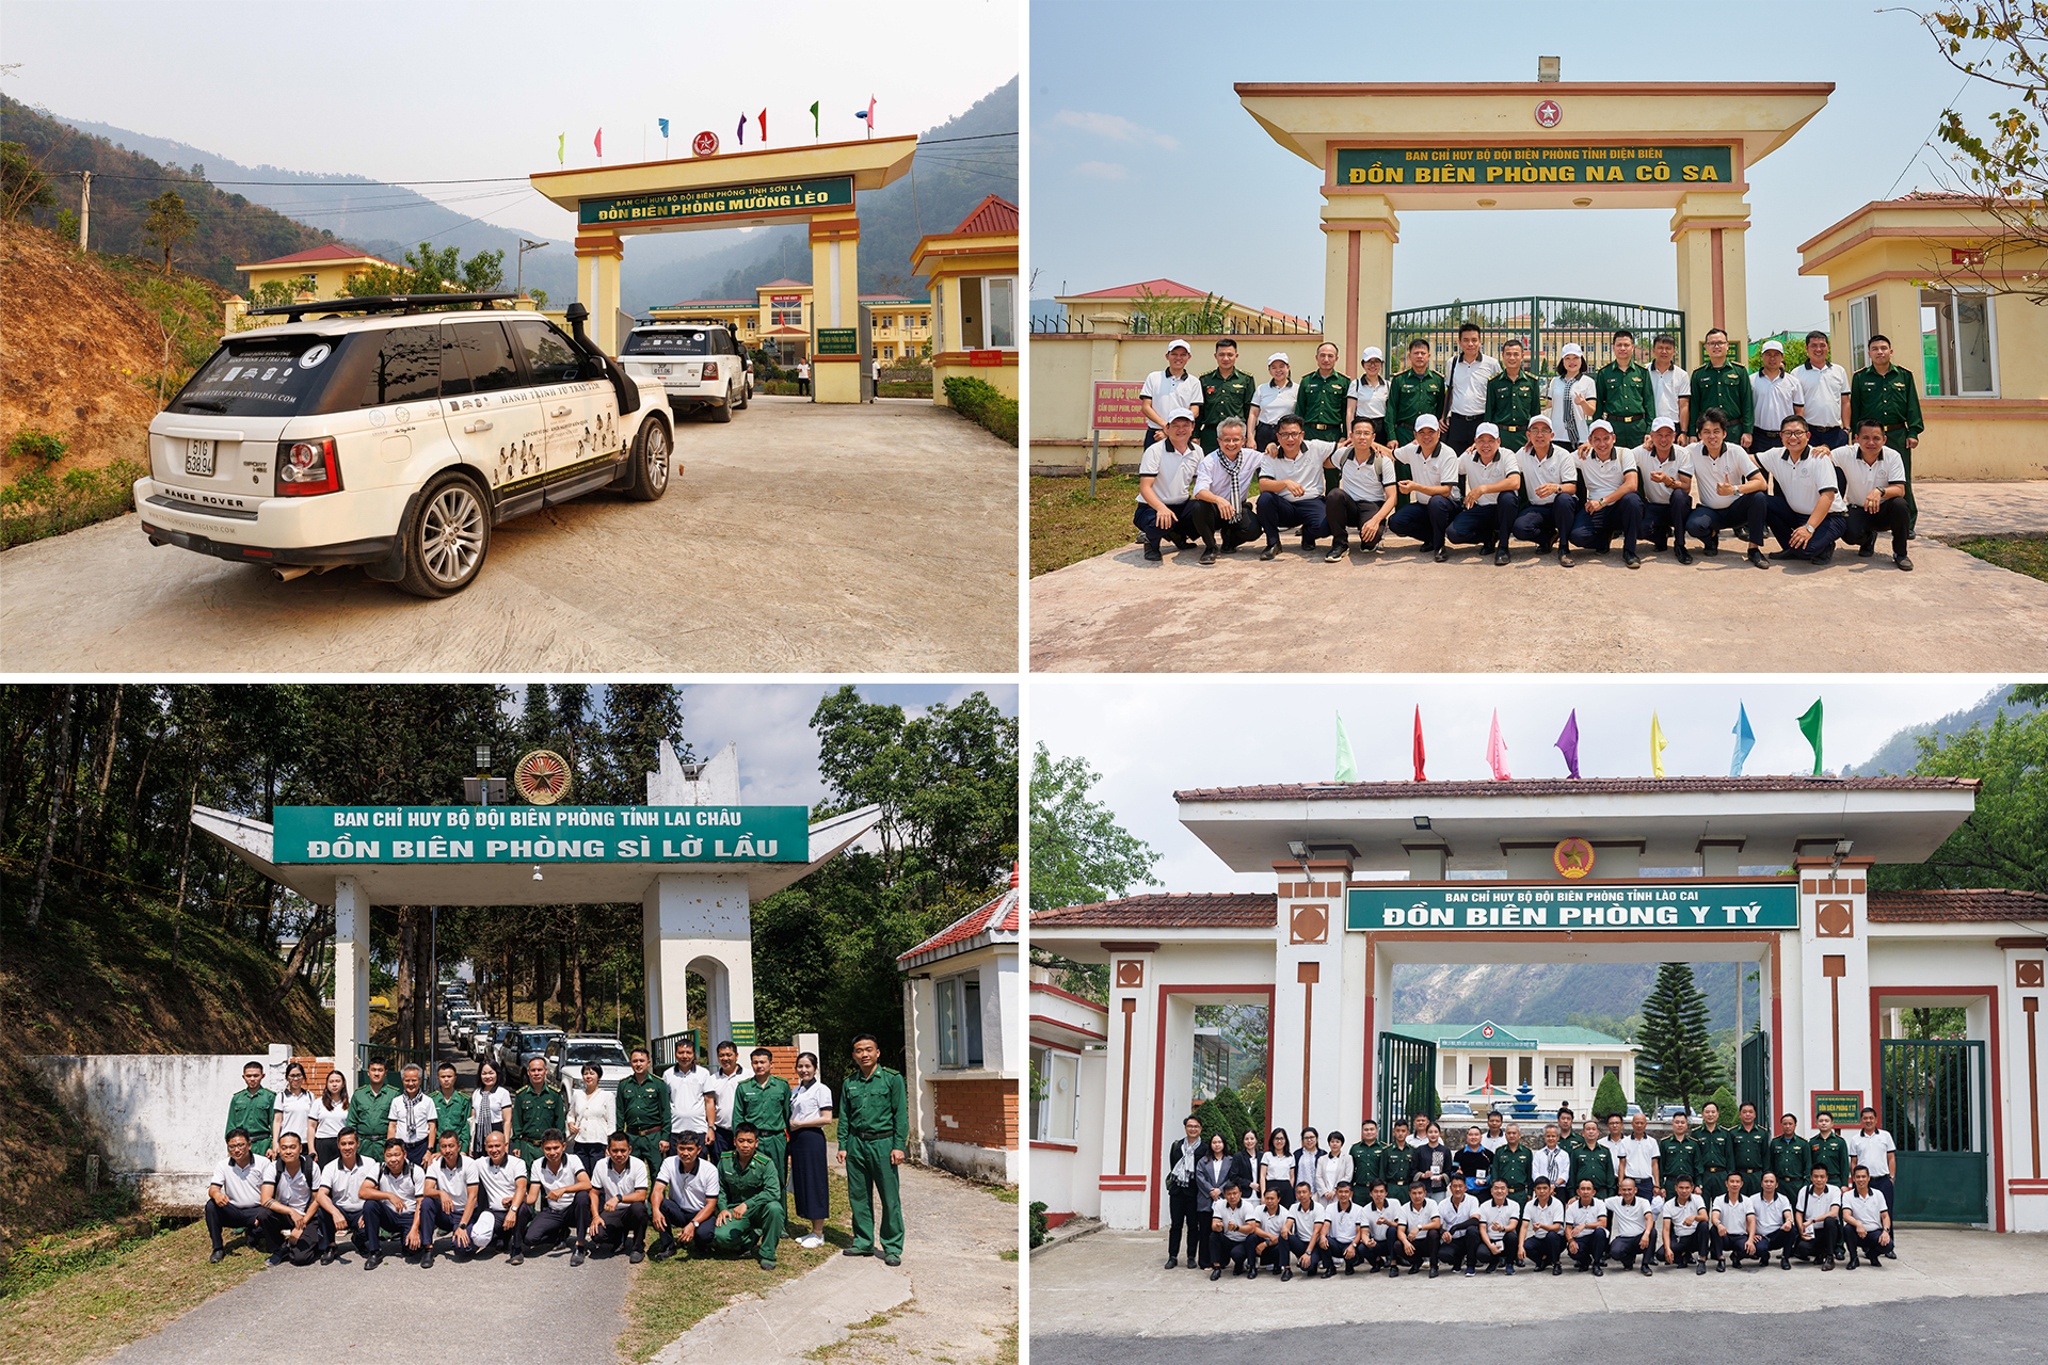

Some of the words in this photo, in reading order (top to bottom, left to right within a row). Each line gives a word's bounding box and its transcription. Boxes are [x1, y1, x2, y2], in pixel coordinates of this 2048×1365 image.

[1405, 151, 1429, 160] BAN
[1431, 149, 1450, 160] CHỈ
[1452, 151, 1474, 160] HUY
[1476, 149, 1491, 162] BỘ
[1493, 149, 1512, 162] ĐỘI
[1514, 148, 1539, 160] BIÊN
[1542, 148, 1580, 160] PHÒNG
[1581, 147, 1607, 160] TỈNH
[1609, 148, 1635, 160] ĐIỆN
[1637, 147, 1663, 159] BIÊN
[1349, 161, 1404, 183] ĐỒN
[1415, 164, 1475, 183] BIÊN
[1486, 161, 1576, 183] PHÒNG
[1586, 165, 1625, 182] NA
[1635, 161, 1671, 182] CÔ
[1682, 165, 1719, 182] SA
[634, 196, 648, 205] CHỈ
[649, 196, 666, 204] HUY
[667, 194, 678, 203] BỘ
[680, 192, 694, 202] ĐỘI
[696, 191, 714, 200] BIÊN
[716, 188, 746, 198] PHÒNG
[748, 186, 767, 195] TỈNH
[770, 184, 788, 193] SƠN
[598, 204, 629, 220] ĐỒN
[632, 204, 668, 218] BIÊN
[671, 200, 726, 215] PHÒNG
[728, 194, 792, 210] MƯỜNG
[794, 190, 829, 205] LÈO
[308, 348, 324, 364] 4
[1098, 388, 1111, 399] KHU
[1112, 387, 1124, 401] VỰC
[192, 440, 208, 456] 51G
[186, 456, 212, 473] 538.94
[165, 488, 196, 500] RANGE
[202, 496, 244, 508] ROVER
[334, 812, 369, 827] BAN
[372, 807, 402, 827] CHỈ
[408, 812, 442, 826] HUY
[446, 808, 470, 830] BỘ
[475, 808, 505, 830] ĐỘI
[510, 808, 550, 826] BIÊN
[556, 808, 615, 826] PHÒNG
[620, 807, 659, 826] TỈNH
[665, 812, 691, 826] LAI
[696, 808, 742, 826] CHÂU
[307, 832, 380, 858] ĐỒN
[392, 835, 474, 858] BIÊN
[486, 834, 604, 858] PHÒNG
[617, 834, 650, 858] SÌ
[662, 834, 704, 858] LỜ
[714, 832, 778, 858] LẦU
[1445, 893, 1469, 902] BAN
[1472, 890, 1490, 902] CHỈ
[1493, 892, 1515, 902] HUY
[1518, 891, 1532, 903] BỘ
[1535, 890, 1554, 903] ĐỘI
[1557, 890, 1583, 902] BIÊN
[1586, 890, 1624, 901] PHÒNG
[1626, 888, 1652, 901] TỈNH
[1656, 890, 1677, 900] LÀO
[1680, 891, 1698, 900] CAI
[1382, 901, 1454, 926] ĐỒN
[1466, 904, 1547, 926] BIÊN
[1559, 902, 1678, 925] PHÒNG
[1690, 906, 1711, 924] Y
[1722, 902, 1762, 924] TÝ
